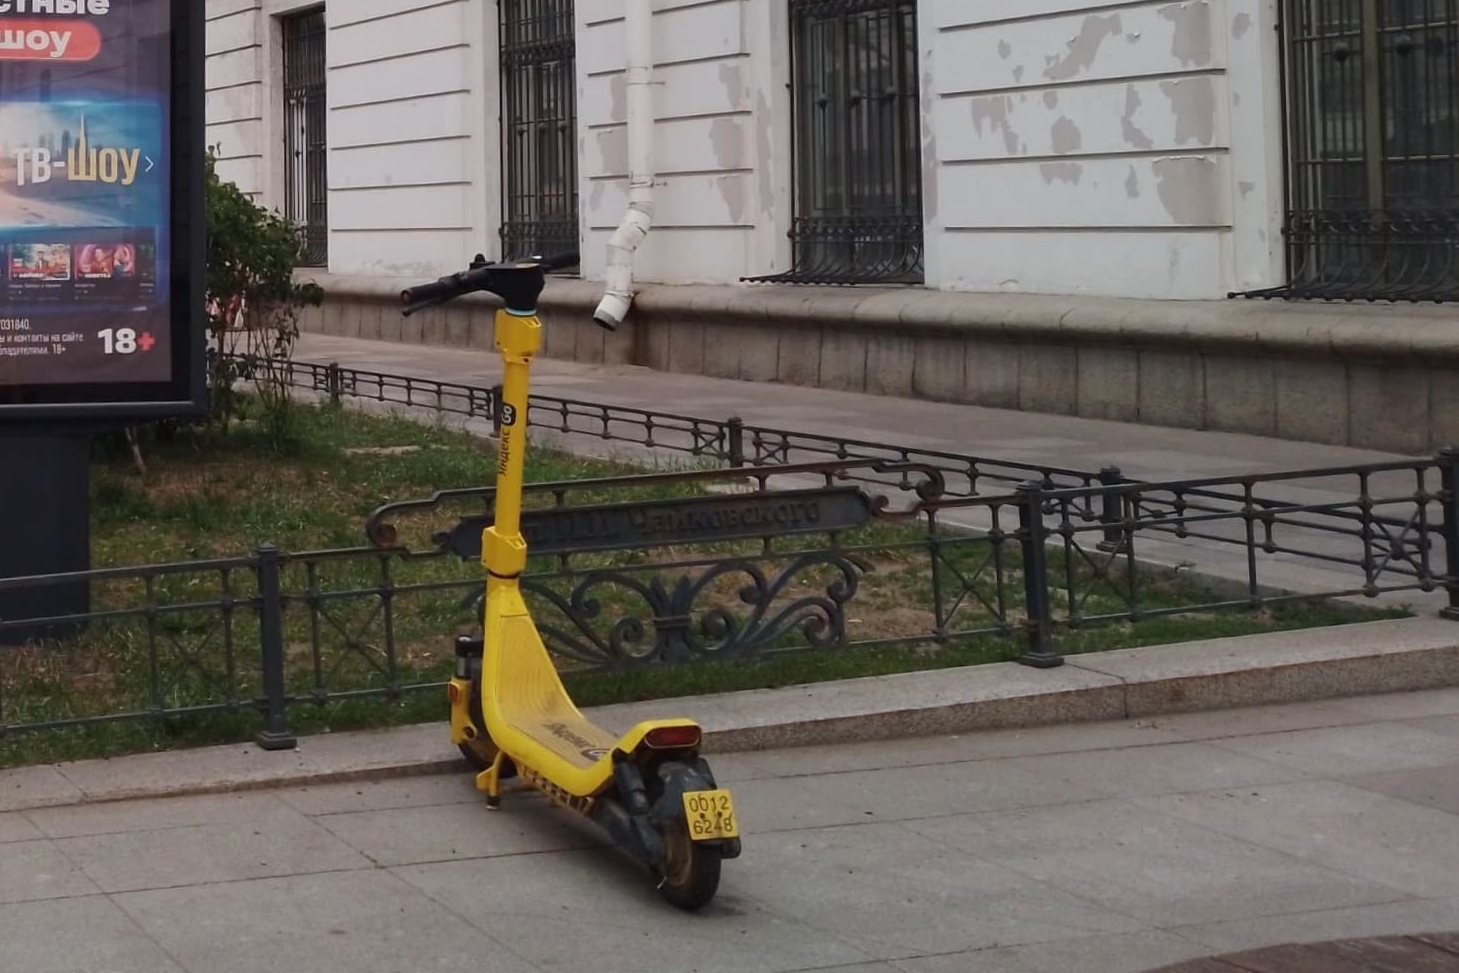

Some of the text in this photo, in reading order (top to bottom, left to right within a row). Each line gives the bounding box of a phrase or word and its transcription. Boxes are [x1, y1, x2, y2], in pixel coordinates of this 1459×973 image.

[62, 331, 84, 342] сайте
[97, 327, 155, 354] 18+
[52, 344, 66, 355] 18+
[498, 405, 513, 477] Яндекс Go
[688, 793, 730, 813] 0012
[693, 812, 734, 835] 6248
